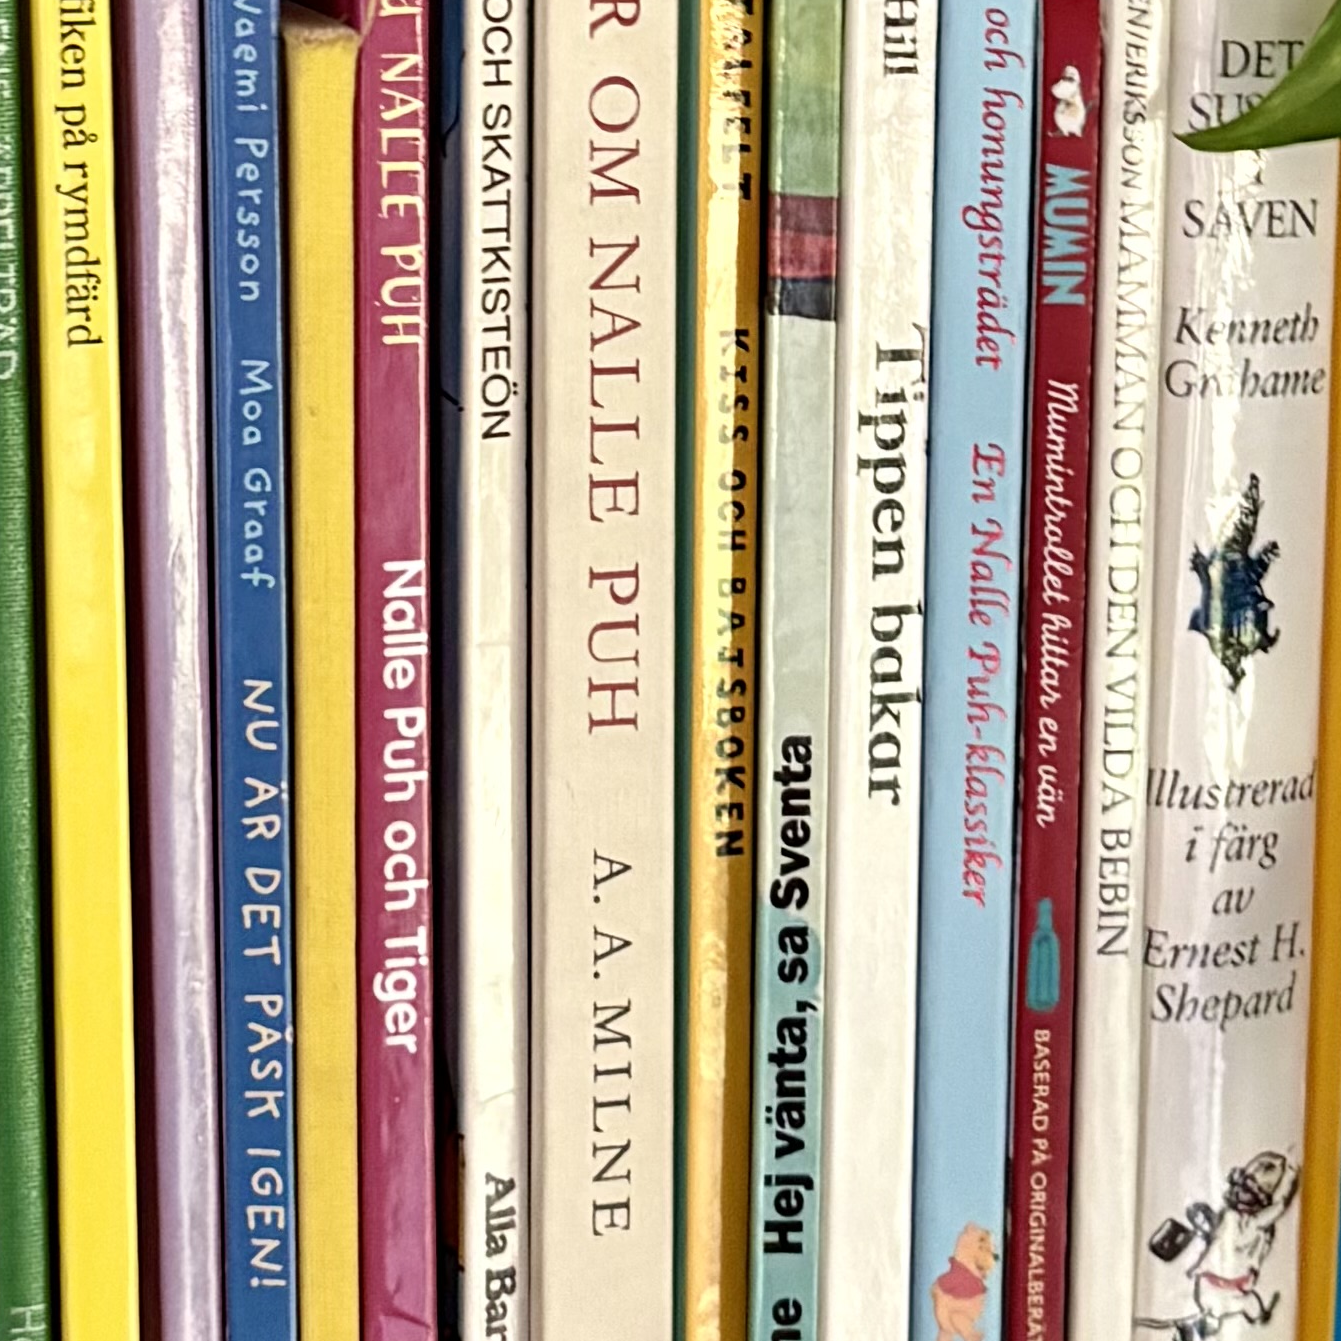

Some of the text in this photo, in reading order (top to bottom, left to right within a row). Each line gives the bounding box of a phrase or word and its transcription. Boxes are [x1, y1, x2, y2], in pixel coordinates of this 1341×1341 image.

[982, 7, 1027, 71] och
[54, 104, 98, 150] på
[380, 52, 426, 219] NALLE
[588, 76, 642, 206] OM
[56, 161, 103, 349] rymdfärd
[235, 137, 269, 303] Persson
[380, 245, 426, 346] PUH
[481, 103, 520, 440] SKATTKISTEÖN
[962, 87, 1026, 371] honungsträdet
[1042, 163, 1093, 306] MUMIN
[589, 235, 642, 523] NALLE
[240, 359, 276, 590] Moa Graaf
[856, 322, 929, 806] Tippen bakar
[587, 562, 640, 735] PUH
[962, 443, 1012, 908] En Nalle Puh-klassiker
[1035, 615, 1073, 828] hittar vän
[1097, 447, 1142, 957] OCH DEN VILDA BEBIN
[373, 560, 430, 1054] Nalle Puh och Tiger
[770, 735, 813, 911] Sventa
[1147, 760, 1315, 809] Illustrerad
[1209, 824, 1279, 872] färg
[777, 925, 810, 984] sa
[1145, 926, 1259, 970] Ernest
[1211, 884, 1255, 916] av
[242, 680, 294, 1288] NU ÄR DET PÅSK IGEN!
[1150, 970, 1297, 1032] Shepard
[591, 998, 633, 1236] MILNE
[766, 999, 820, 1159] vänta,
[1029, 1137, 1052, 1166] PÅ
[1031, 1028, 1052, 1132] BASERAD
[484, 1171, 517, 1257] Alla
[763, 1173, 814, 1255] Hej
